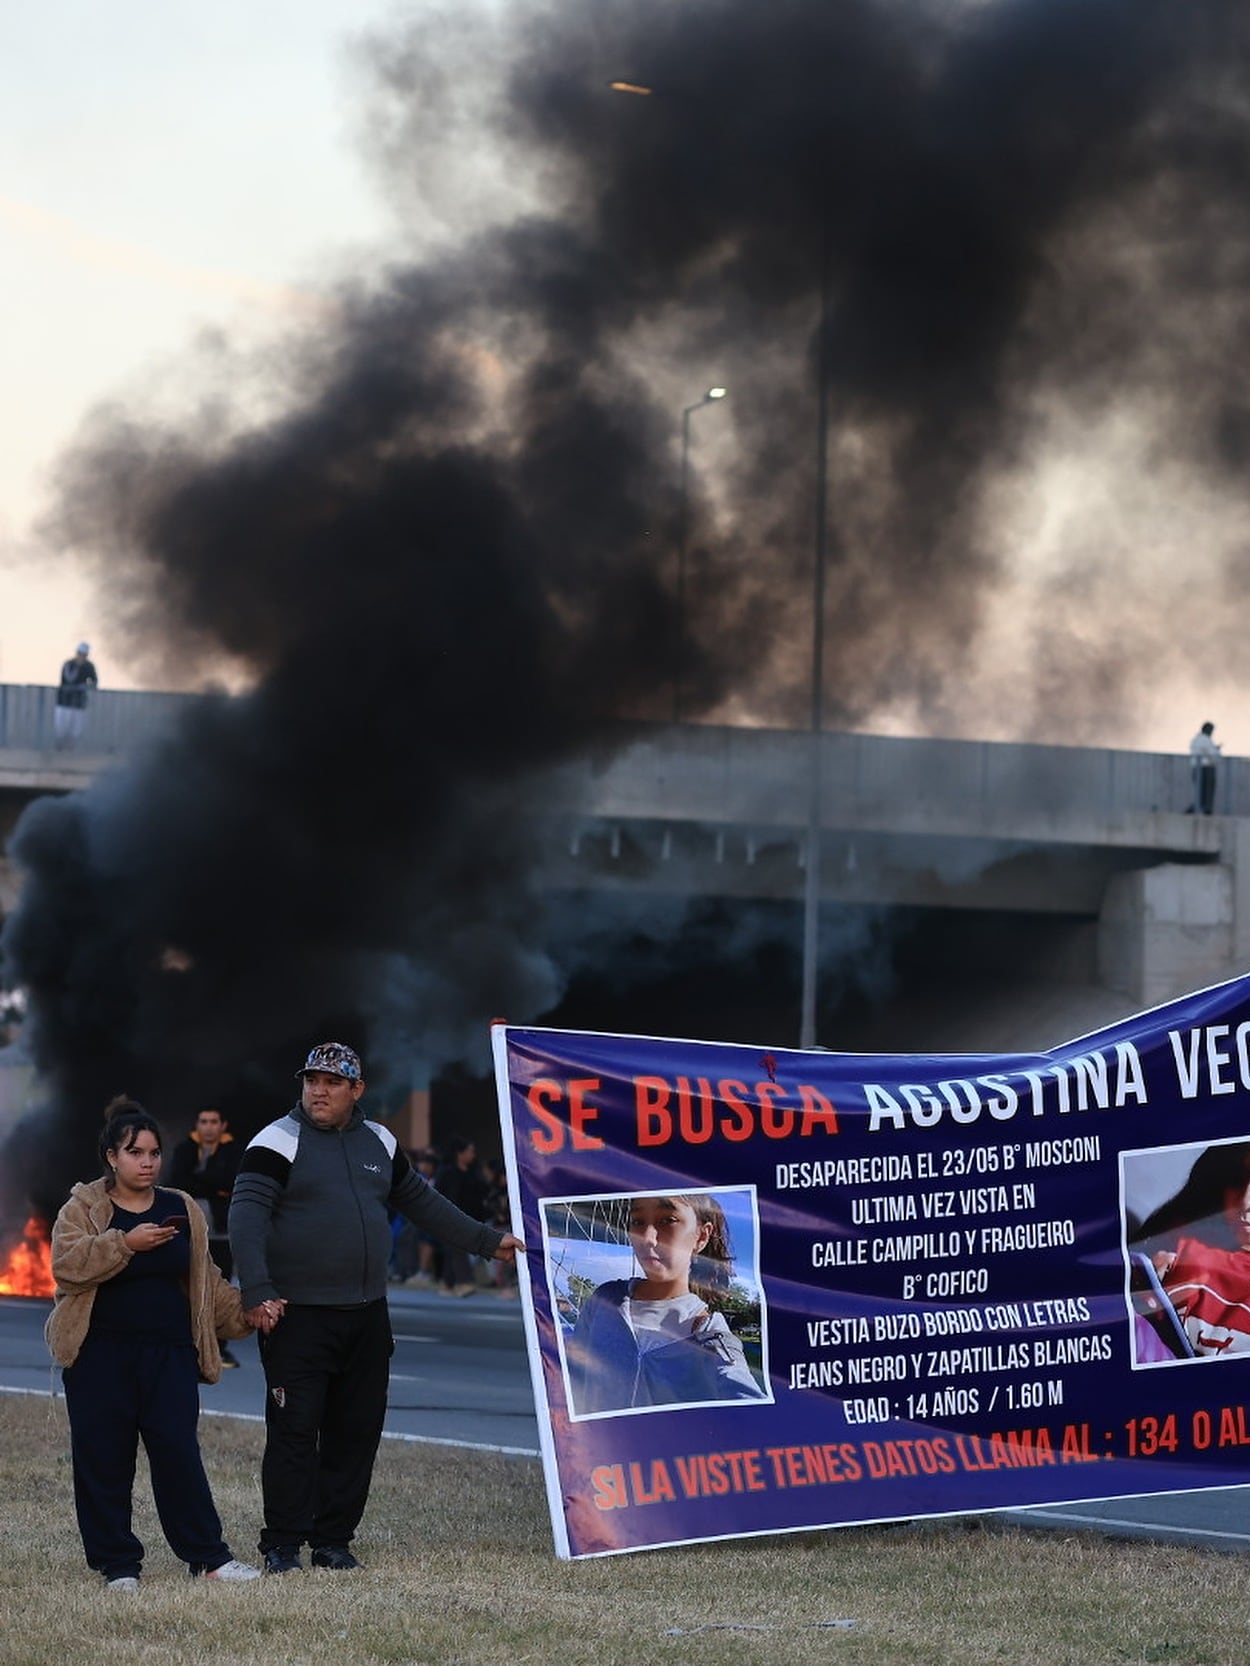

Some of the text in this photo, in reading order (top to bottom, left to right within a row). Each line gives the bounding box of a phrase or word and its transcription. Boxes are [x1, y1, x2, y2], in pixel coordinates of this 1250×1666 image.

[527, 1078, 606, 1155] SE
[632, 1075, 839, 1147] BUSCA
[863, 1041, 1149, 1131] AGOSTINA
[775, 1154, 913, 1189] DESAPARECIDA
[916, 1152, 939, 1179] EL
[942, 1146, 999, 1176] 23/05
[1025, 1135, 1101, 1169] MOSCONI
[851, 1183, 1036, 1225] ULTIMA VEZ VISTA EN
[811, 1219, 1075, 1268] CALLE CAMPILLO Y FRAGUEIRO
[926, 1268, 989, 1298] COFICO
[806, 1296, 1091, 1347] VESTIA BUZO BORDO CON LETRAS
[788, 1334, 1112, 1390] JEANS NEGRO Y ZAPATILLAS BLANCAS
[842, 1396, 890, 1424] EDAD
[906, 1394, 928, 1420] 14
[931, 1386, 980, 1416] AÑOS
[1006, 1382, 1044, 1410] 1.60
[1047, 1380, 1064, 1406] M
[590, 1463, 629, 1511] SI
[629, 1458, 676, 1505] LA
[675, 1450, 766, 1499] VISTE
[765, 1442, 862, 1488] TENES
[862, 1435, 956, 1480] DATOS
[956, 1426, 1056, 1473] LLAMA
[1061, 1423, 1099, 1464] AL
[1124, 1413, 1178, 1457] 134
